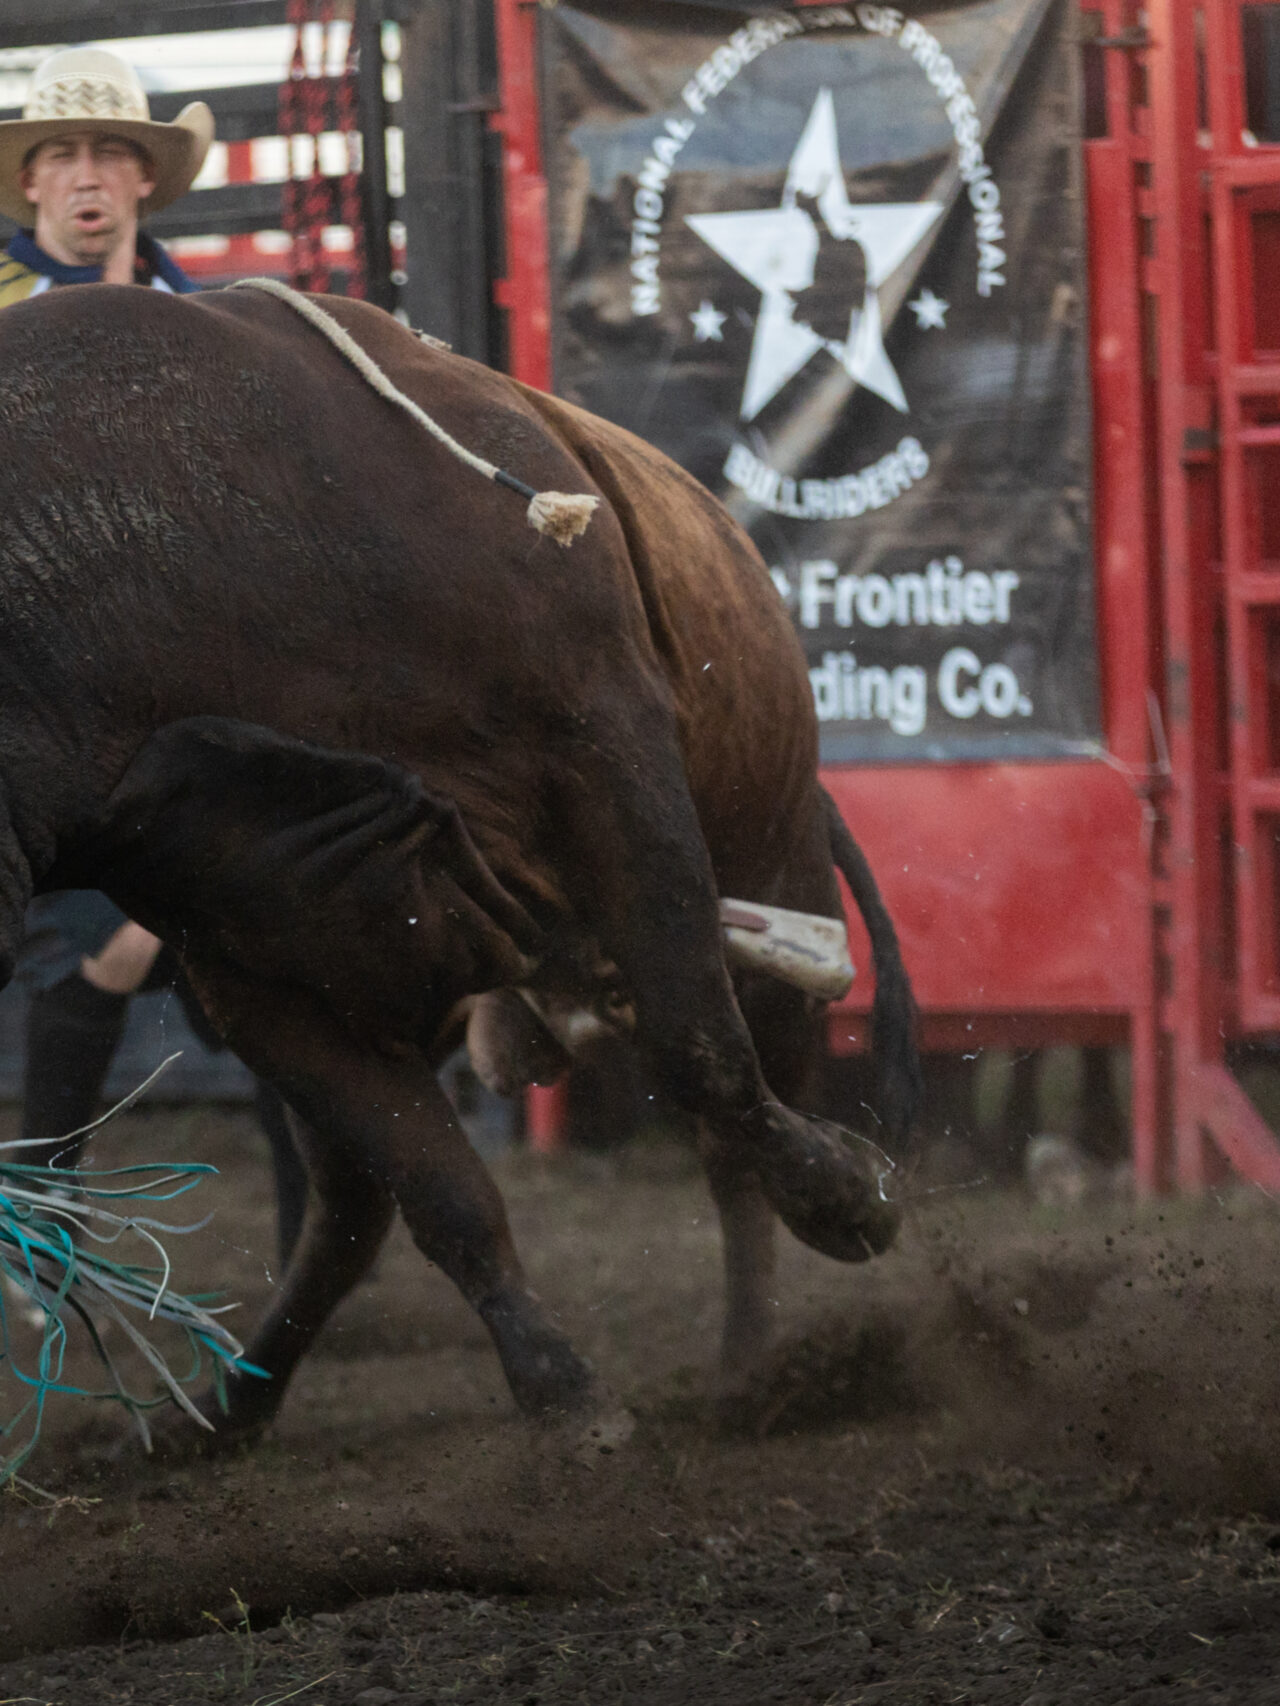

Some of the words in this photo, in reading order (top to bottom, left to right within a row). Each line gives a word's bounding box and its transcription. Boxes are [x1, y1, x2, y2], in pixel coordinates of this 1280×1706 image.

[631, 119, 696, 316] NATIONAL
[855, 4, 904, 37] OF
[899, 19, 1006, 297] PROFESSIONAL
[799, 557, 1020, 628] Frontier
[937, 648, 1033, 719] Co.
